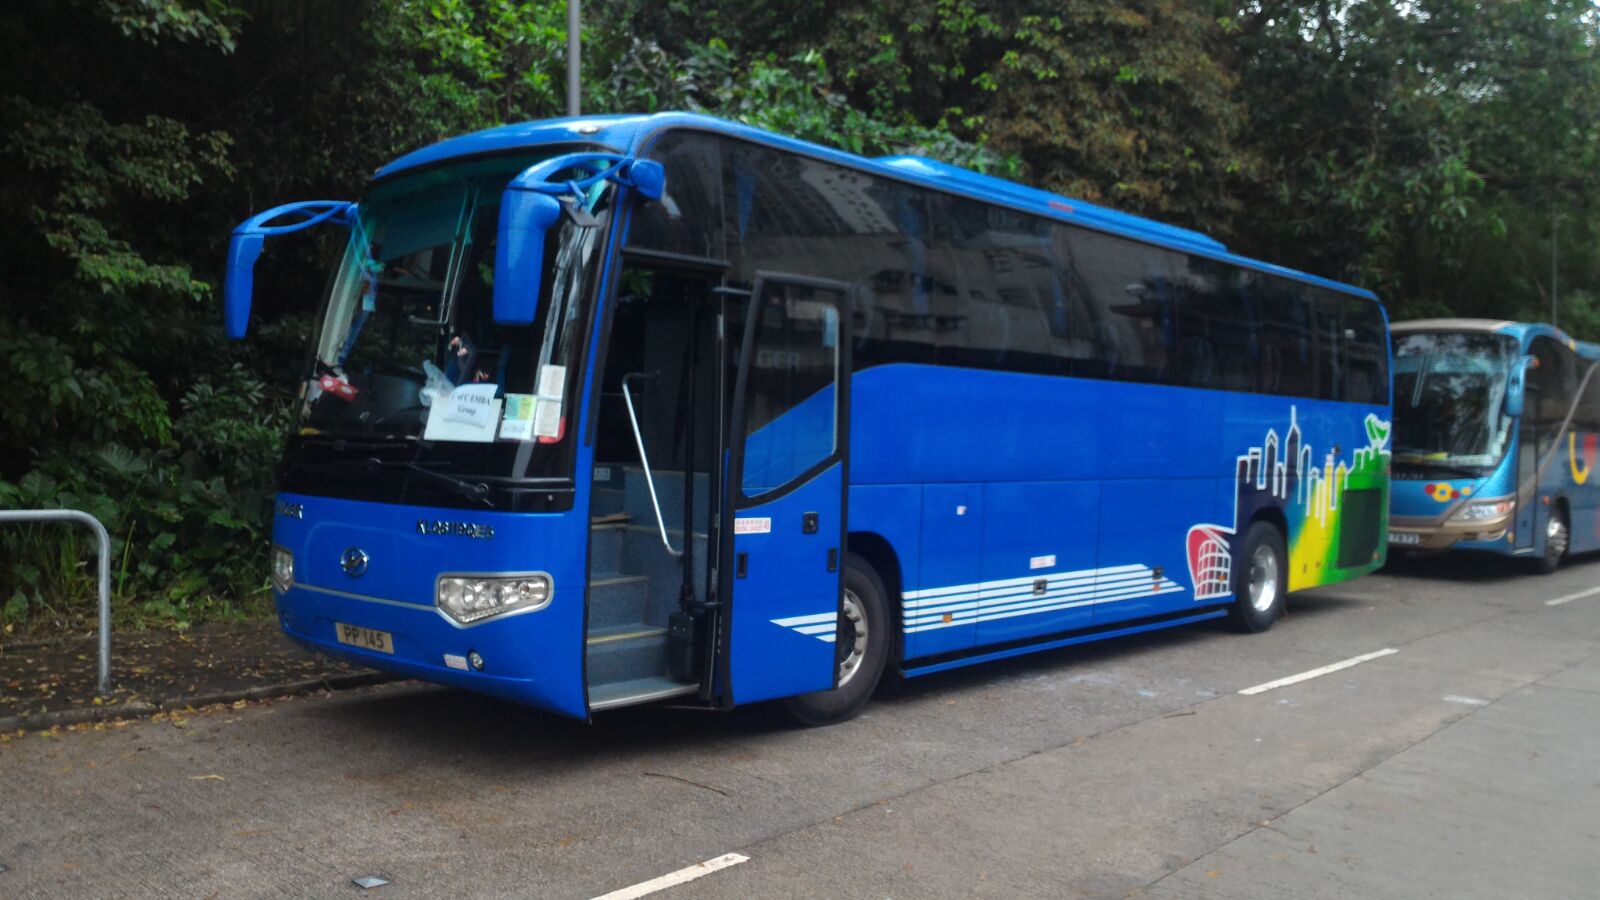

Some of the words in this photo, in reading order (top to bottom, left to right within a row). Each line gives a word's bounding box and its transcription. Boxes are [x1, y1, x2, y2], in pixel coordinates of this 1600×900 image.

[457, 405, 477, 416] Group
[343, 624, 359, 643] PP
[363, 629, 384, 649] 145
